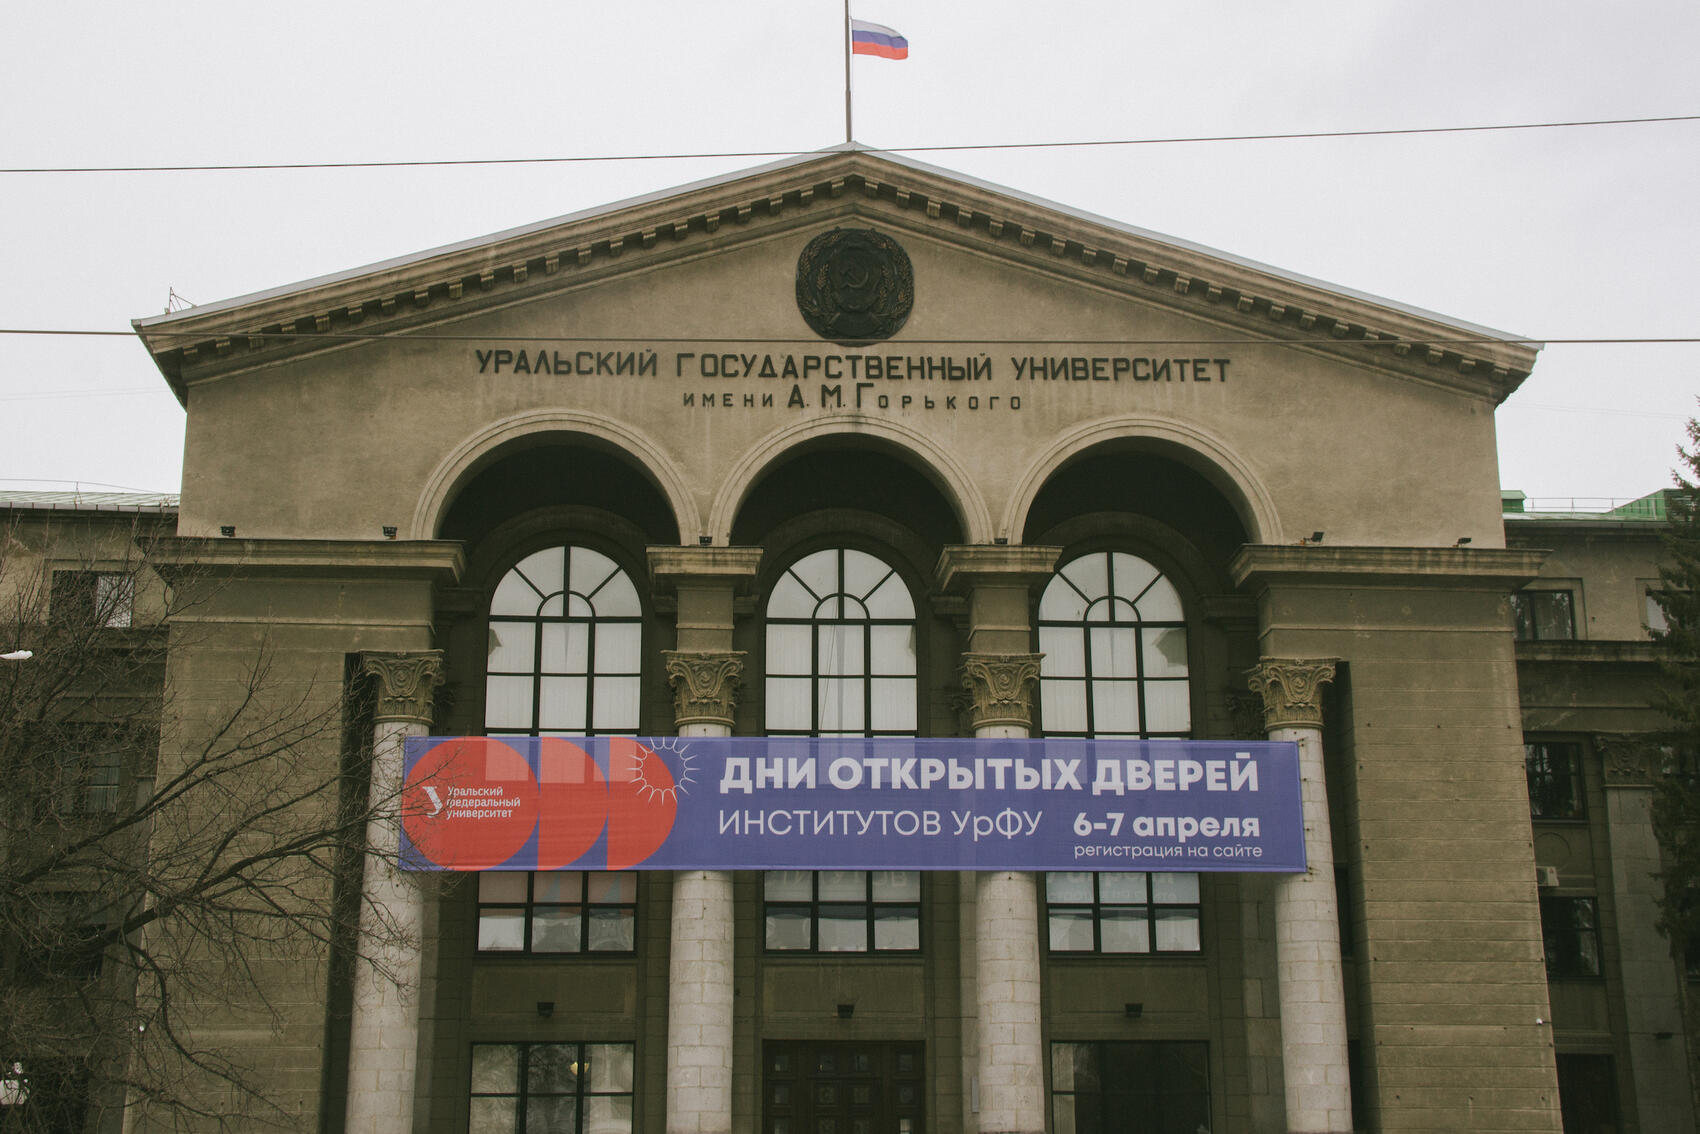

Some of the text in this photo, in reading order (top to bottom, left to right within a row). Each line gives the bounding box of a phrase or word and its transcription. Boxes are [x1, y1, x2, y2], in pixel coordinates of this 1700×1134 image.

[475, 348, 1231, 383] УРАЛЬСКИЙ ГОСУДАРСТВЕННЫЙ УНИВЕРСИТЕТ
[719, 751, 1259, 796] ДНИ ОТКРЫТЫХ ДВЕРЕЙ
[447, 785, 503, 798] Уральский
[446, 809, 512, 820] университет
[719, 807, 1043, 842] ИНСТИТУТОВ УрФУ
[1072, 812, 1261, 844] 6-7 апреля
[1074, 843, 1263, 860] регистрация на сайте
